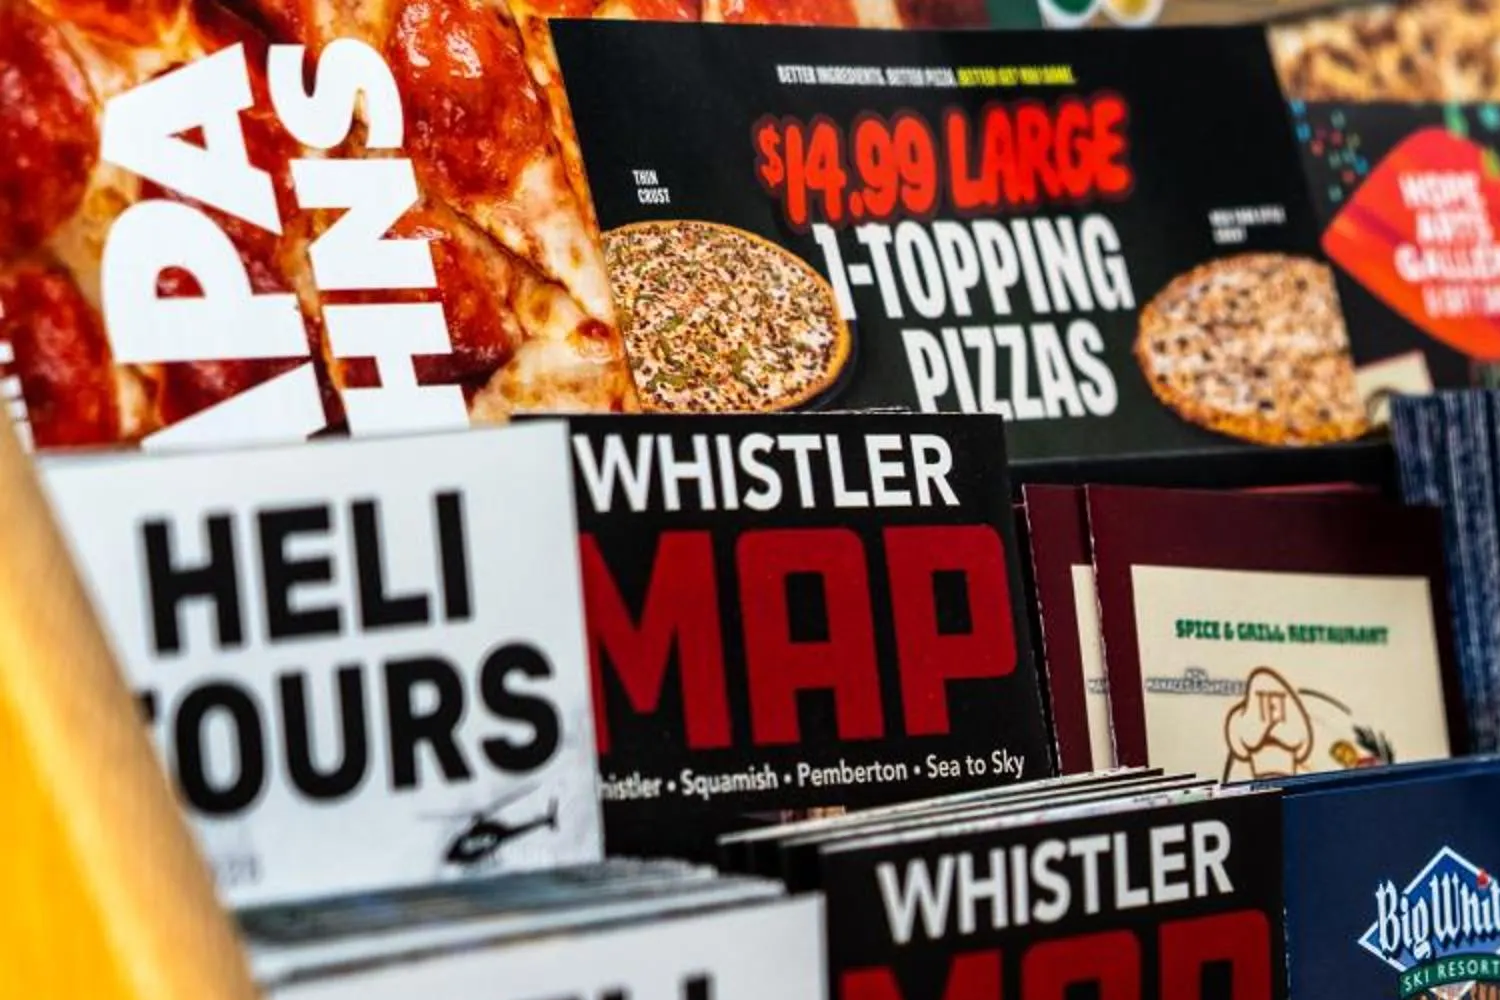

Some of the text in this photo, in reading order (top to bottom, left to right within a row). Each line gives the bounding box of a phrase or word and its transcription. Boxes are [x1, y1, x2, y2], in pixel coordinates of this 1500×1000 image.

[632, 169, 659, 185] THIN
[638, 187, 671, 204] CRUST
[757, 95, 1130, 226] $14.99 LARGE
[812, 213, 1136, 320] 1-TOPPING
[901, 319, 1118, 421] PIZZAS
[574, 432, 960, 513] WHISTLER
[140, 490, 473, 657] HELI
[580, 525, 1017, 755] MAP
[1175, 619, 1389, 645] SPICE & GRILL RESTAURANT
[137, 641, 562, 818] OURS
[596, 748, 1025, 802] histler Squamish Pemberton Sea to Sky
[876, 819, 1235, 944] WHISTLER
[1404, 958, 1500, 993] SKI RESORT
